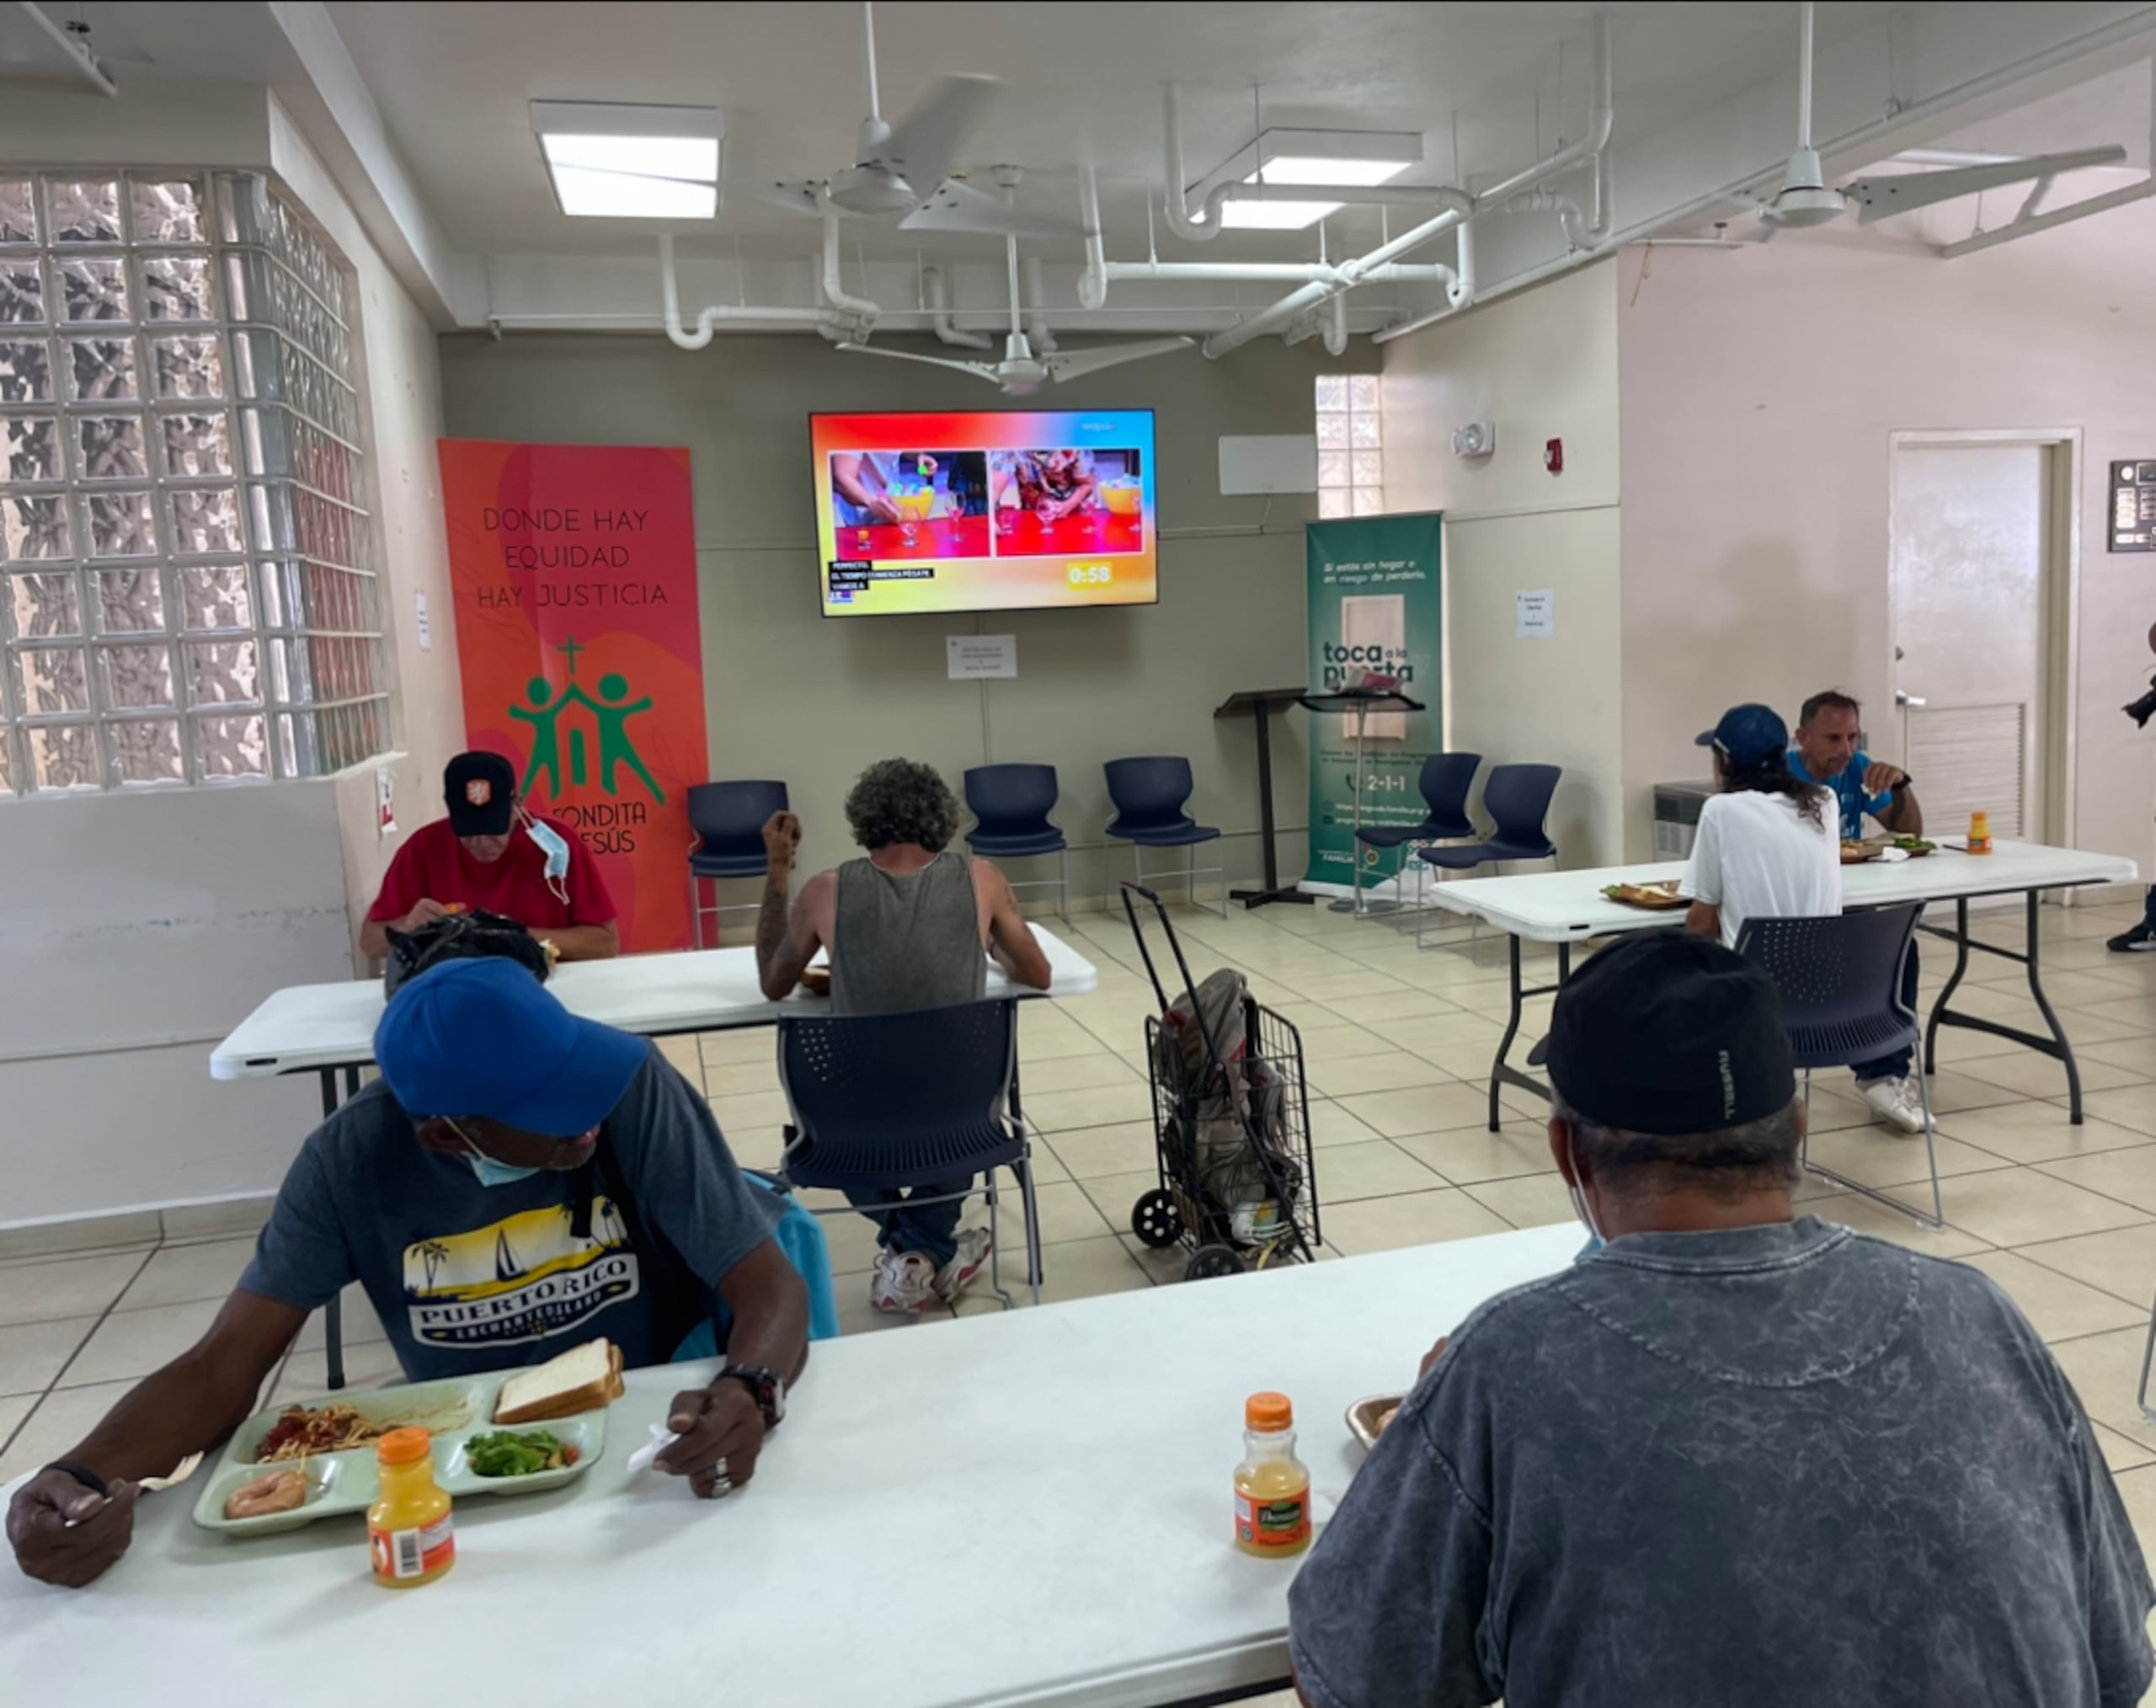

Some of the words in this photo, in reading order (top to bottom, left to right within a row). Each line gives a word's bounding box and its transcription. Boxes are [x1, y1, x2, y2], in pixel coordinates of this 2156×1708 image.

[483, 507, 580, 531] DONDE
[594, 510, 648, 531] HAY
[506, 546, 630, 570] EQUIDAD
[1070, 566, 1111, 584] 0:58
[478, 587, 523, 608] HAY
[536, 584, 668, 606] JUSTICIA
[1323, 641, 1382, 663] toca
[1368, 775, 1406, 791] 2-1-1
[580, 827, 636, 854] ESÚS
[421, 1282, 555, 1325] PUERTO
[563, 1260, 627, 1297] RICO
